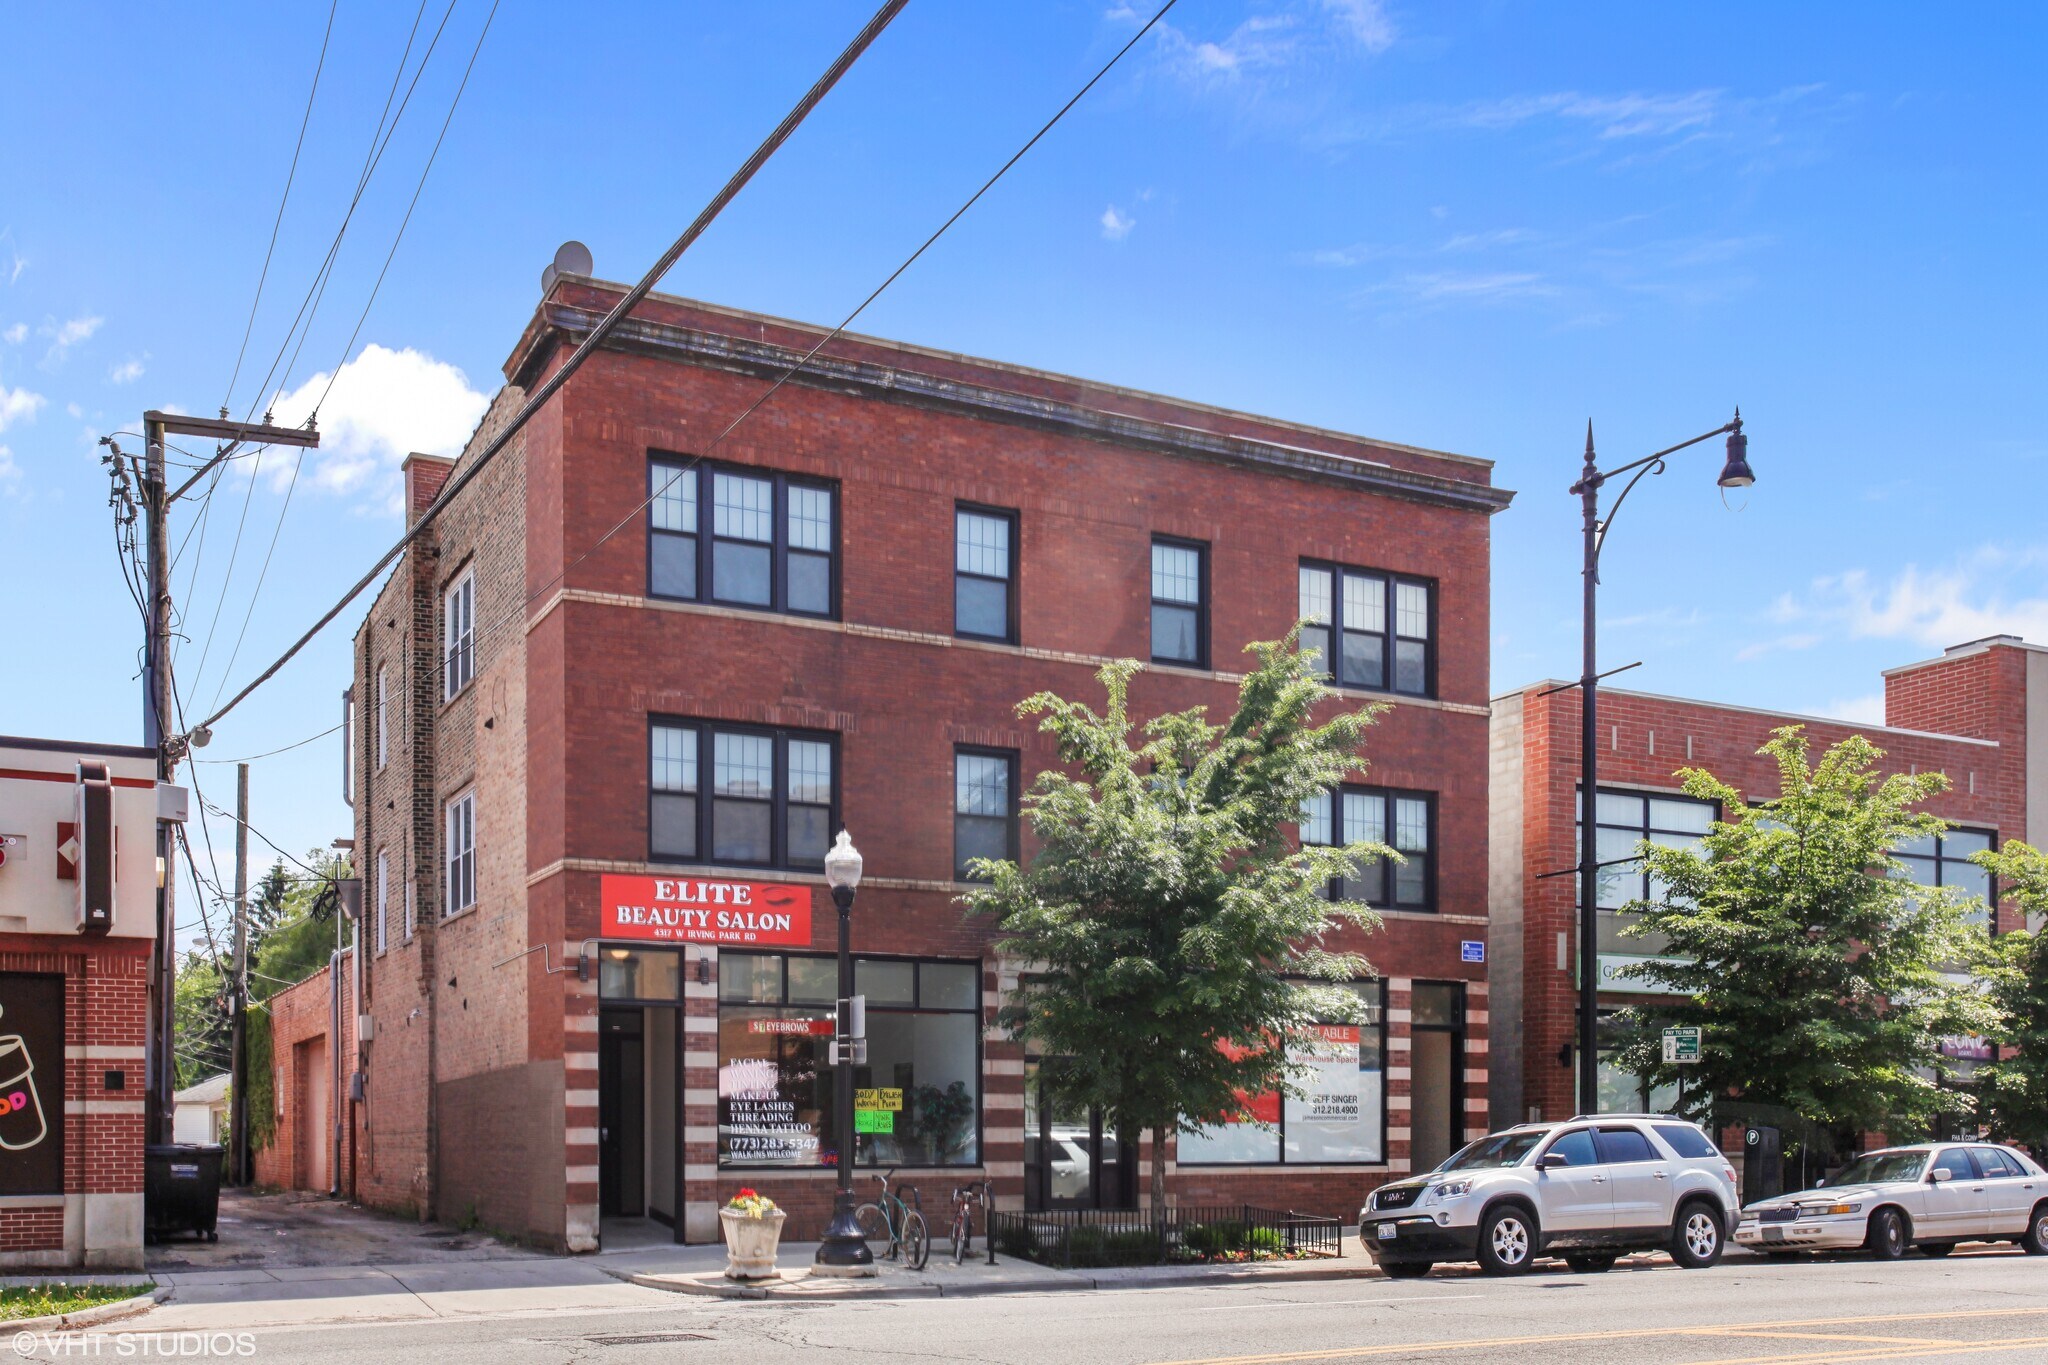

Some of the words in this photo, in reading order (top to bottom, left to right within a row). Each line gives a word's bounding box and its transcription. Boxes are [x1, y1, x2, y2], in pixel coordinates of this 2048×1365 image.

[654, 880, 752, 905] ELITE
[616, 905, 712, 927] BEAUTY
[717, 911, 791, 931] SALON
[654, 929, 672, 938] 4317
[676, 930, 684, 938] W
[688, 930, 716, 940] IRVING
[719, 932, 741, 940] PARK
[745, 933, 757, 941] RD
[766, 1022, 810, 1033] EYEBROWS
[730, 1057, 768, 1067] FACIAL
[1295, 1053, 1335, 1064] Warehouse
[1336, 1055, 1359, 1065] Space
[730, 1069, 774, 1078] WAXING
[730, 1091, 780, 1100] MAKE-UP
[1331, 1095, 1358, 1104] SINGER
[730, 1102, 752, 1111] EYE
[754, 1102, 795, 1111] LASHES
[1313, 1105, 1358, 1115] 312.218.4900
[730, 1113, 793, 1122] THREADING
[730, 1124, 768, 1134] HENNA
[769, 1123, 812, 1134] TATTOO
[1951, 1134, 1961, 1142] FHA
[767, 1150, 802, 1159] WELCOME
